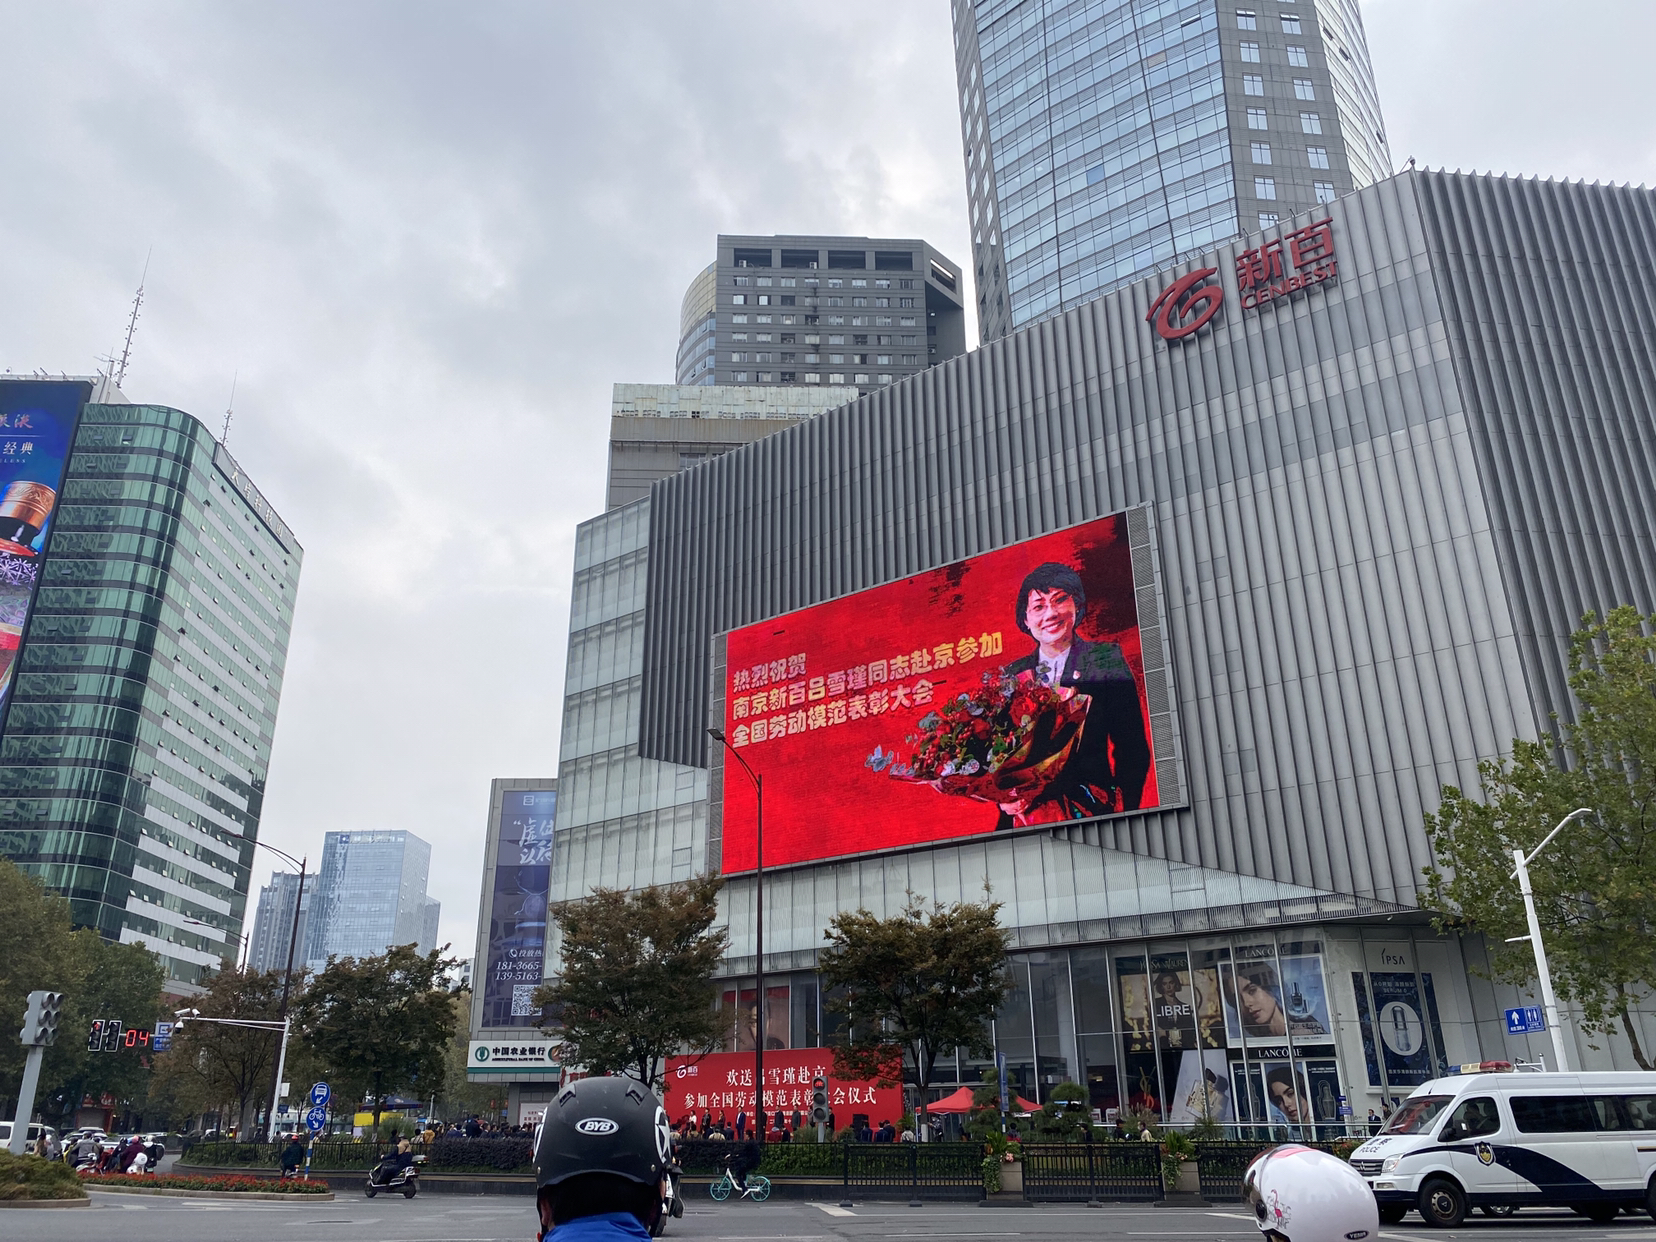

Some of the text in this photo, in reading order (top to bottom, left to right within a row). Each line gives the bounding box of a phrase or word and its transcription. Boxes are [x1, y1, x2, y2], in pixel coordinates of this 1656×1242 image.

[1236, 216, 1333, 291] 新百
[1241, 261, 1338, 310] CENBEST
[733, 652, 807, 692] 热烈祝贺
[732, 679, 934, 748] 全国劳动模范表彰大会
[125, 1029, 149, 1047] 04
[492, 1046, 546, 1056] 中国农业银行
[684, 1087, 877, 1110] 参加全国劳动模范表彰会仪式
[584, 1121, 612, 1132] BYB
